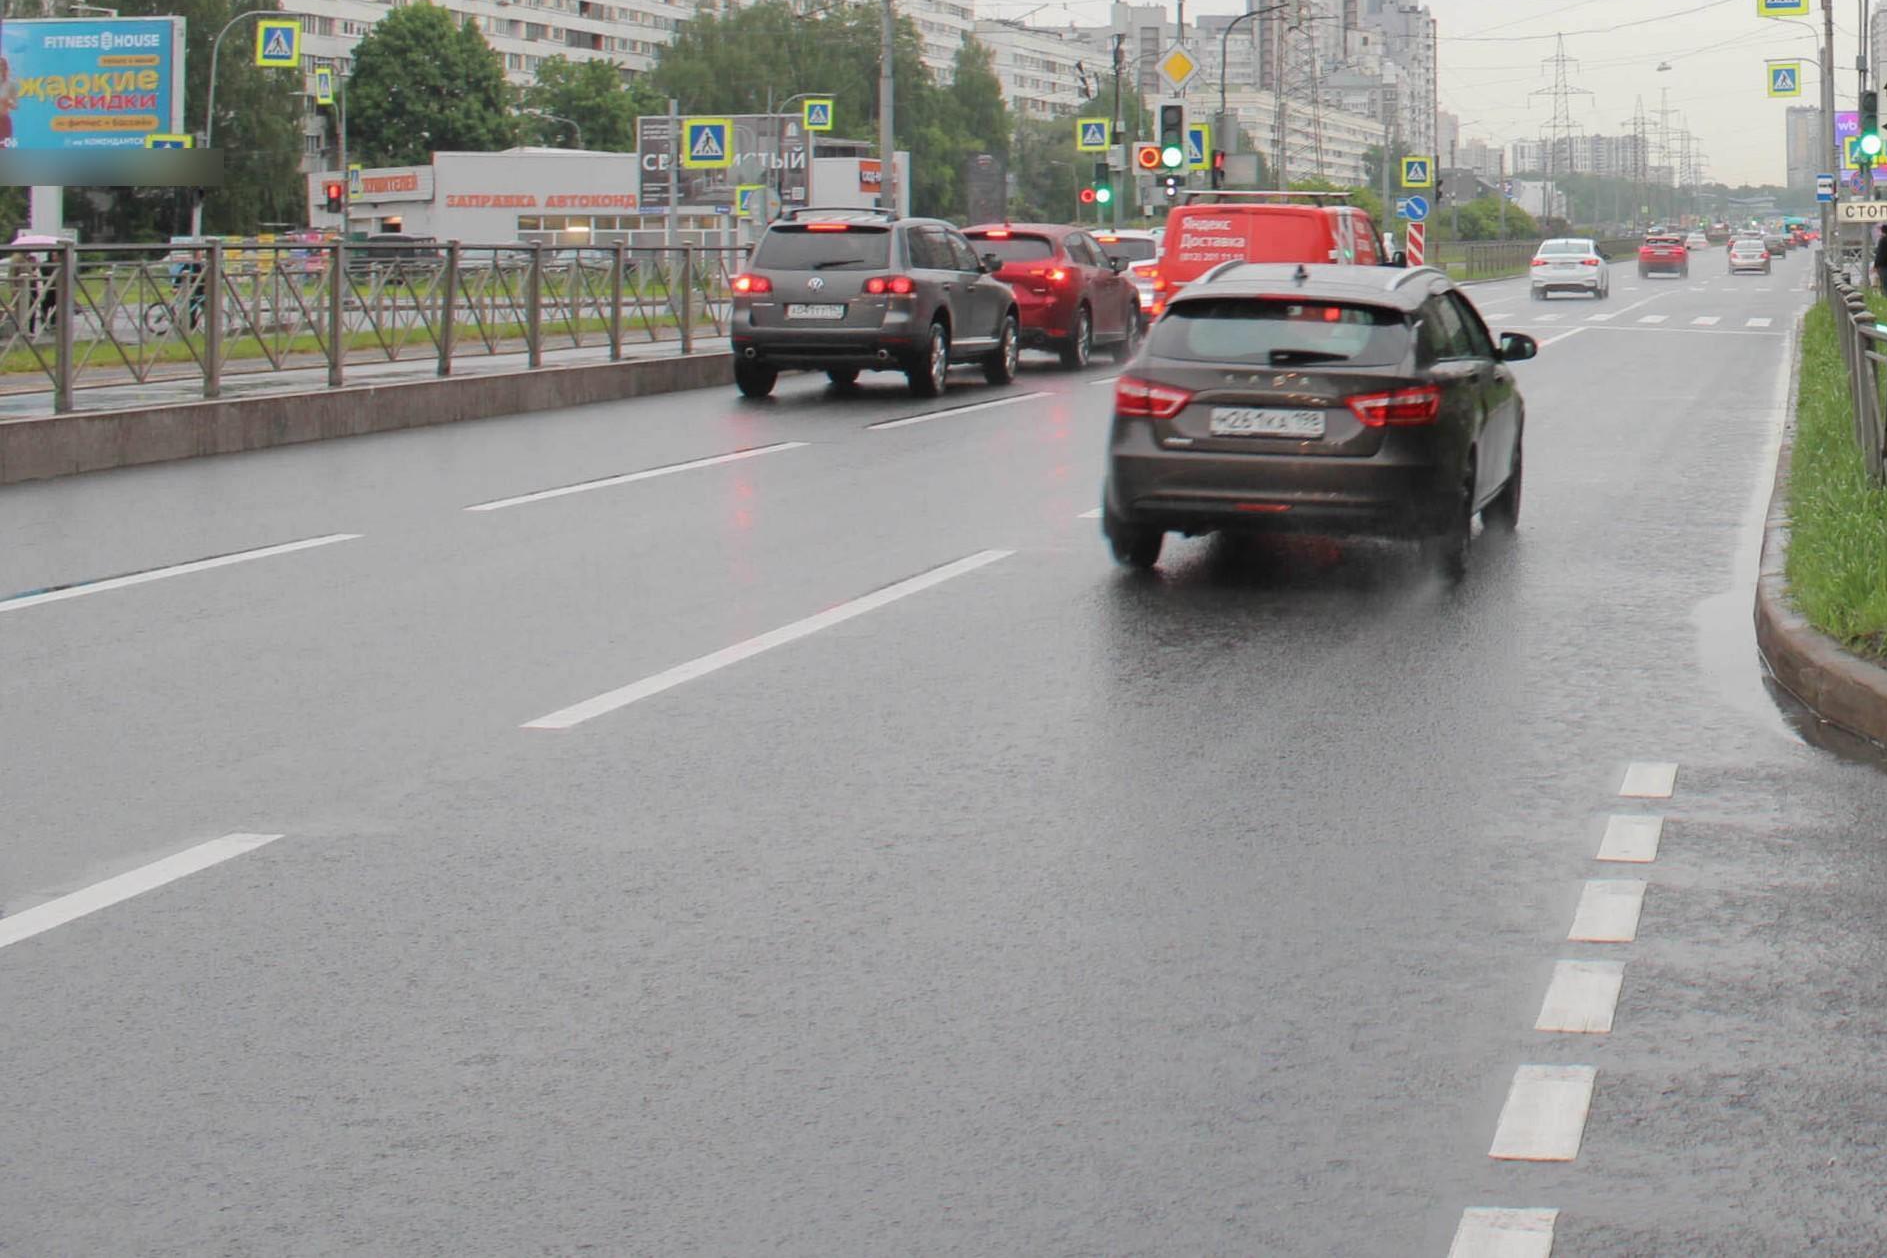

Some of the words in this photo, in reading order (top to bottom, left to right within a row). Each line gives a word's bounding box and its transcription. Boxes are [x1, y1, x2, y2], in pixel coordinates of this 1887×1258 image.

[44, 34, 99, 49] FITNESS
[114, 33, 160, 47] HOUSE
[1838, 120, 1858, 131] wb
[446, 194, 536, 209] ЗАПРАВКА
[545, 194, 637, 210] АВТОКОНД
[1182, 216, 1231, 231] Яндекс
[1180, 233, 1246, 249] Доставка
